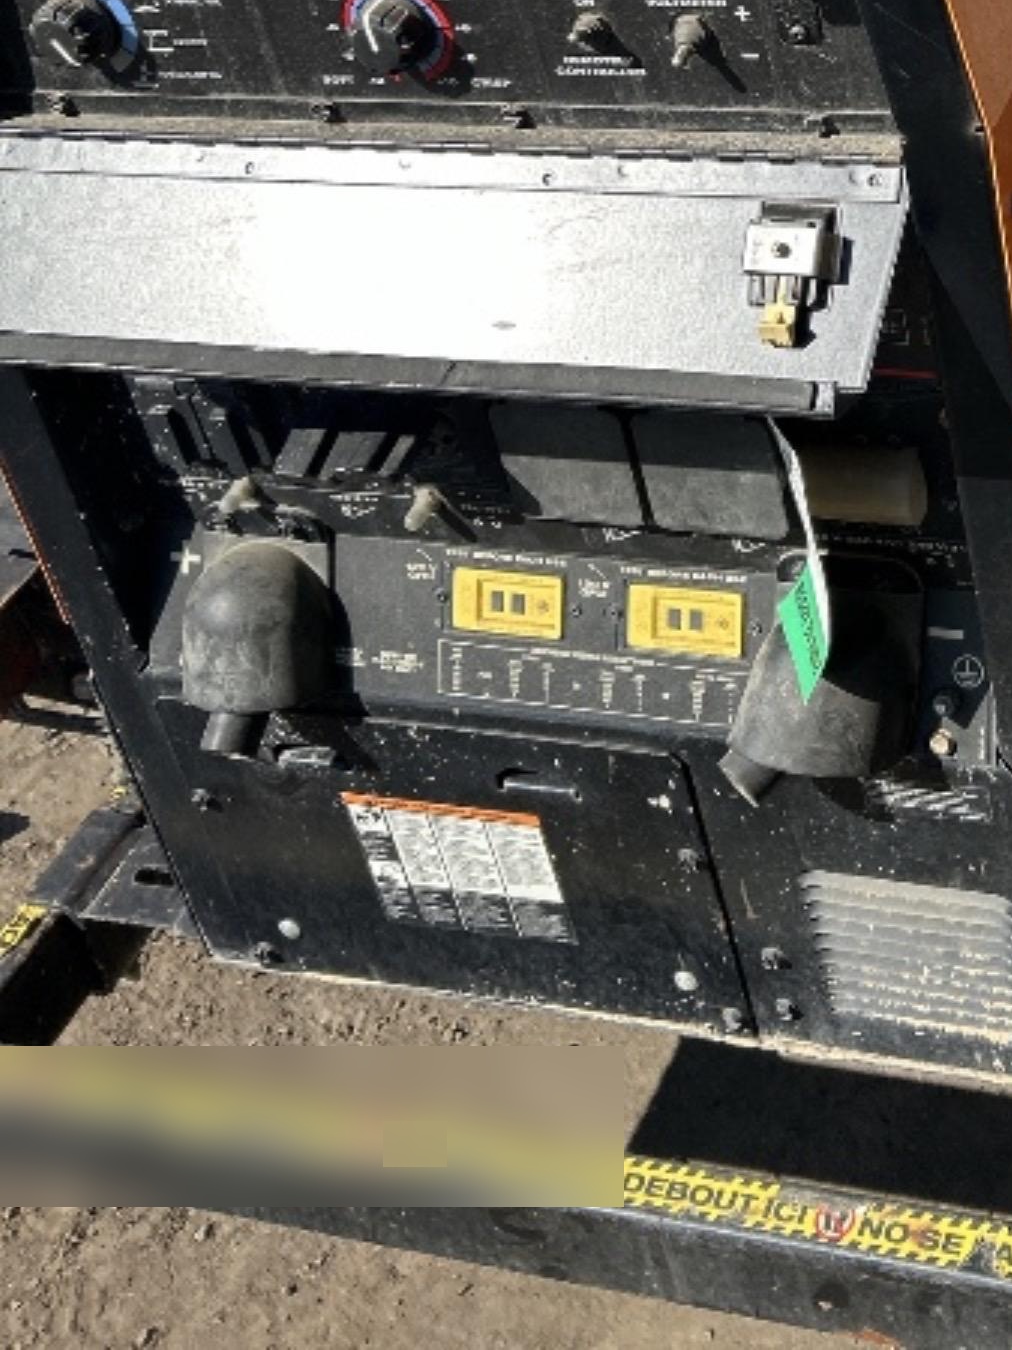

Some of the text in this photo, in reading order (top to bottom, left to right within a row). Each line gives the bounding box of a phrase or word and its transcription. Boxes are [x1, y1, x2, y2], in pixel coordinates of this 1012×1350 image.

[623, 1172, 808, 1224] DEBOUT ICI
[857, 1217, 911, 1245] NO
[917, 1229, 967, 1255] SE
